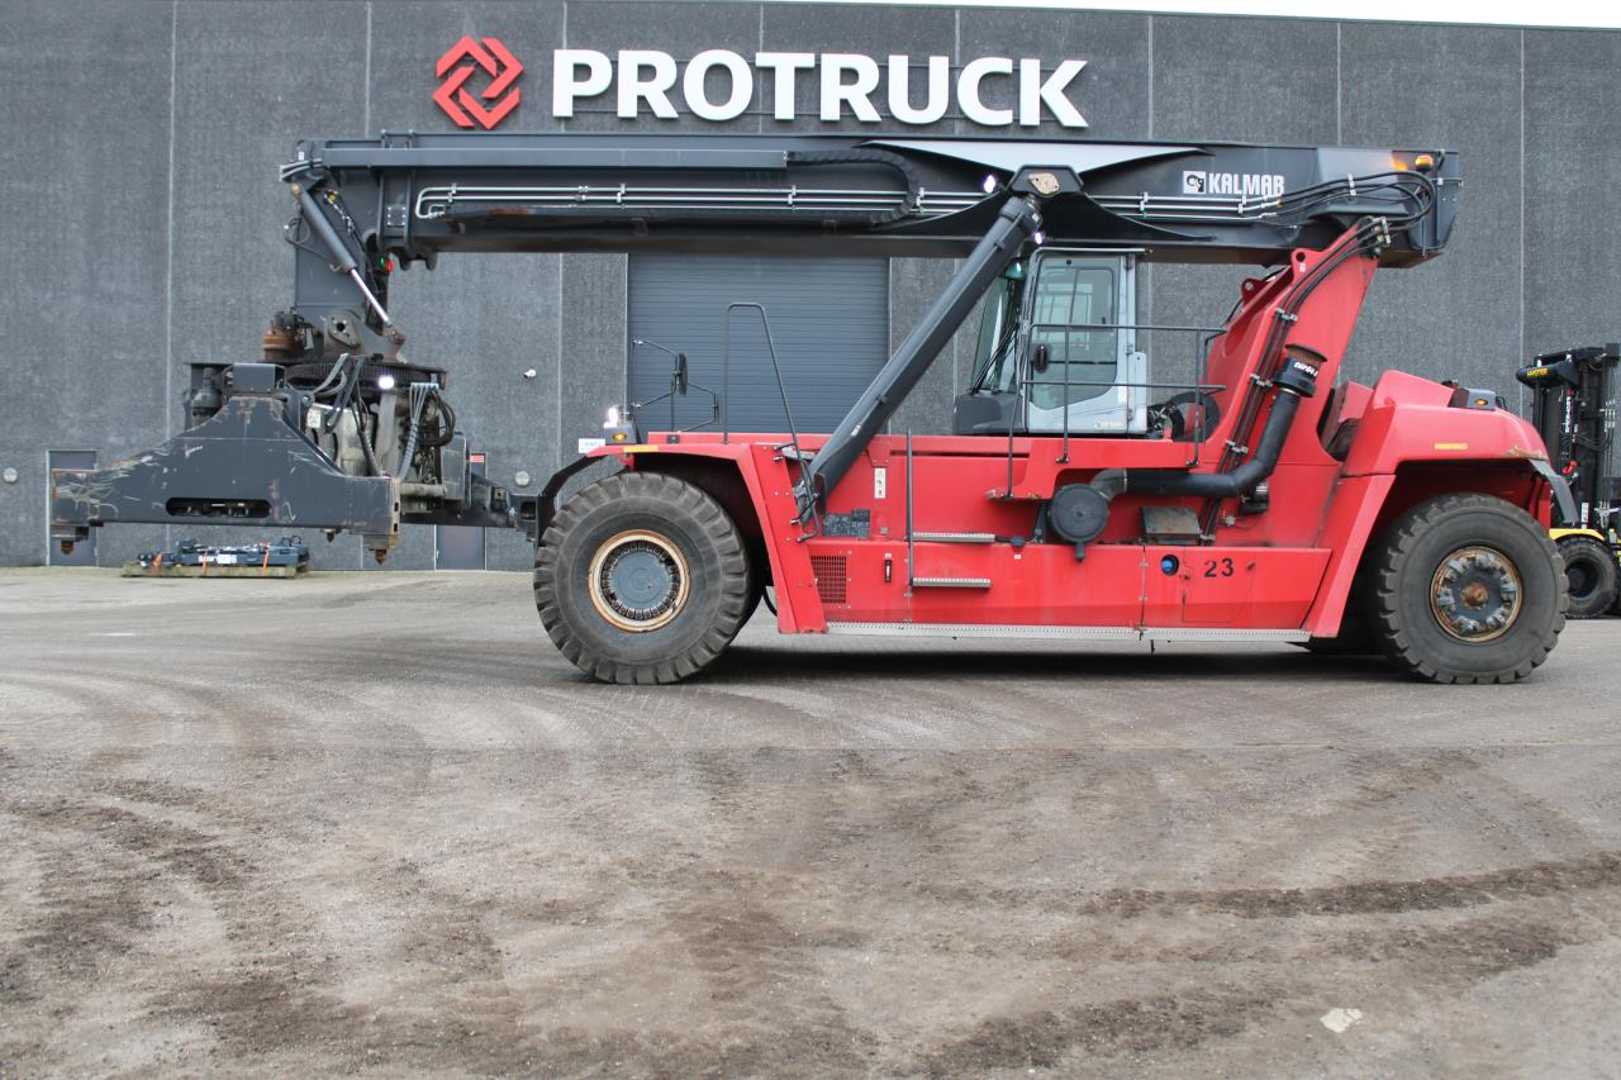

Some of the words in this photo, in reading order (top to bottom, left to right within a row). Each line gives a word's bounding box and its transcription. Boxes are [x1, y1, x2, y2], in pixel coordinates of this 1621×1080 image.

[552, 48, 1089, 128] PROTRUCK
[1208, 172, 1285, 197] KALMAR
[1203, 557, 1234, 579] 23
